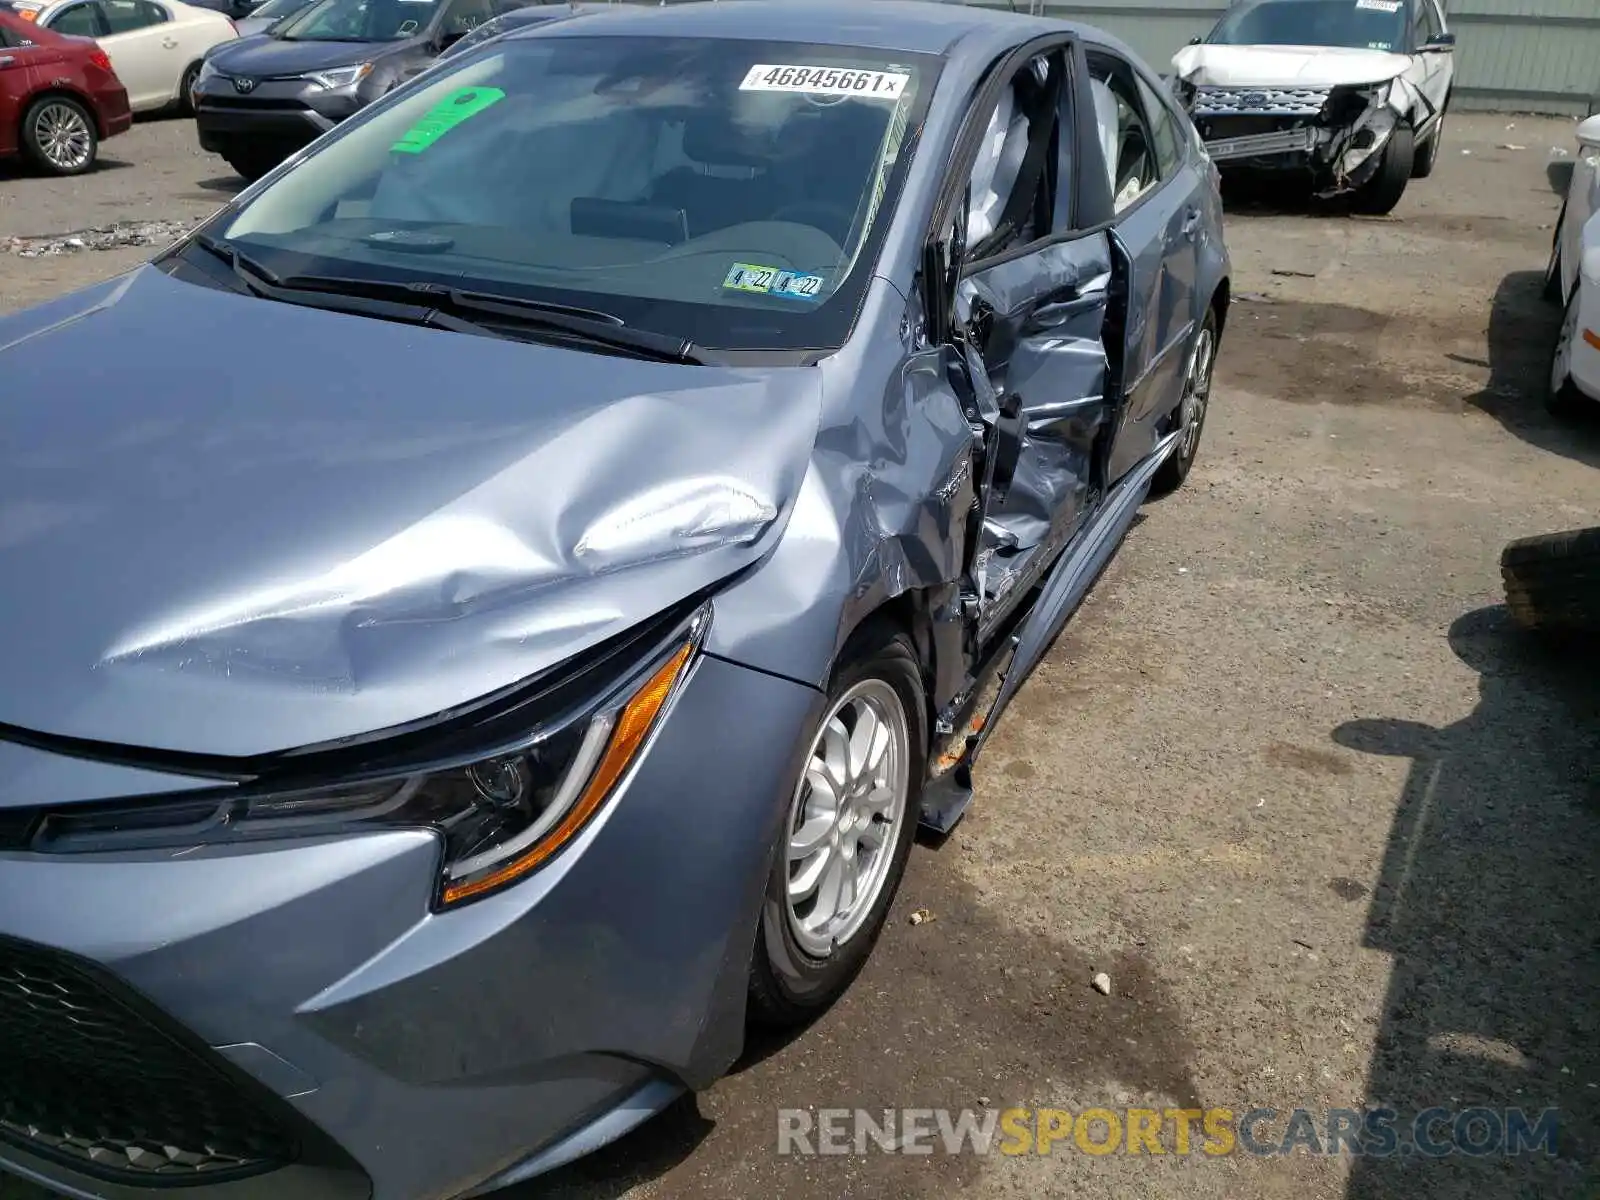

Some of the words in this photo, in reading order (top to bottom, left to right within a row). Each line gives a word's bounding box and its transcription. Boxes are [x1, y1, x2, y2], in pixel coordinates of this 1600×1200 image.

[734, 270, 744, 285] 4
[753, 270, 772, 288] 22
[780, 276, 791, 292] 4
[800, 277, 819, 295] 22
